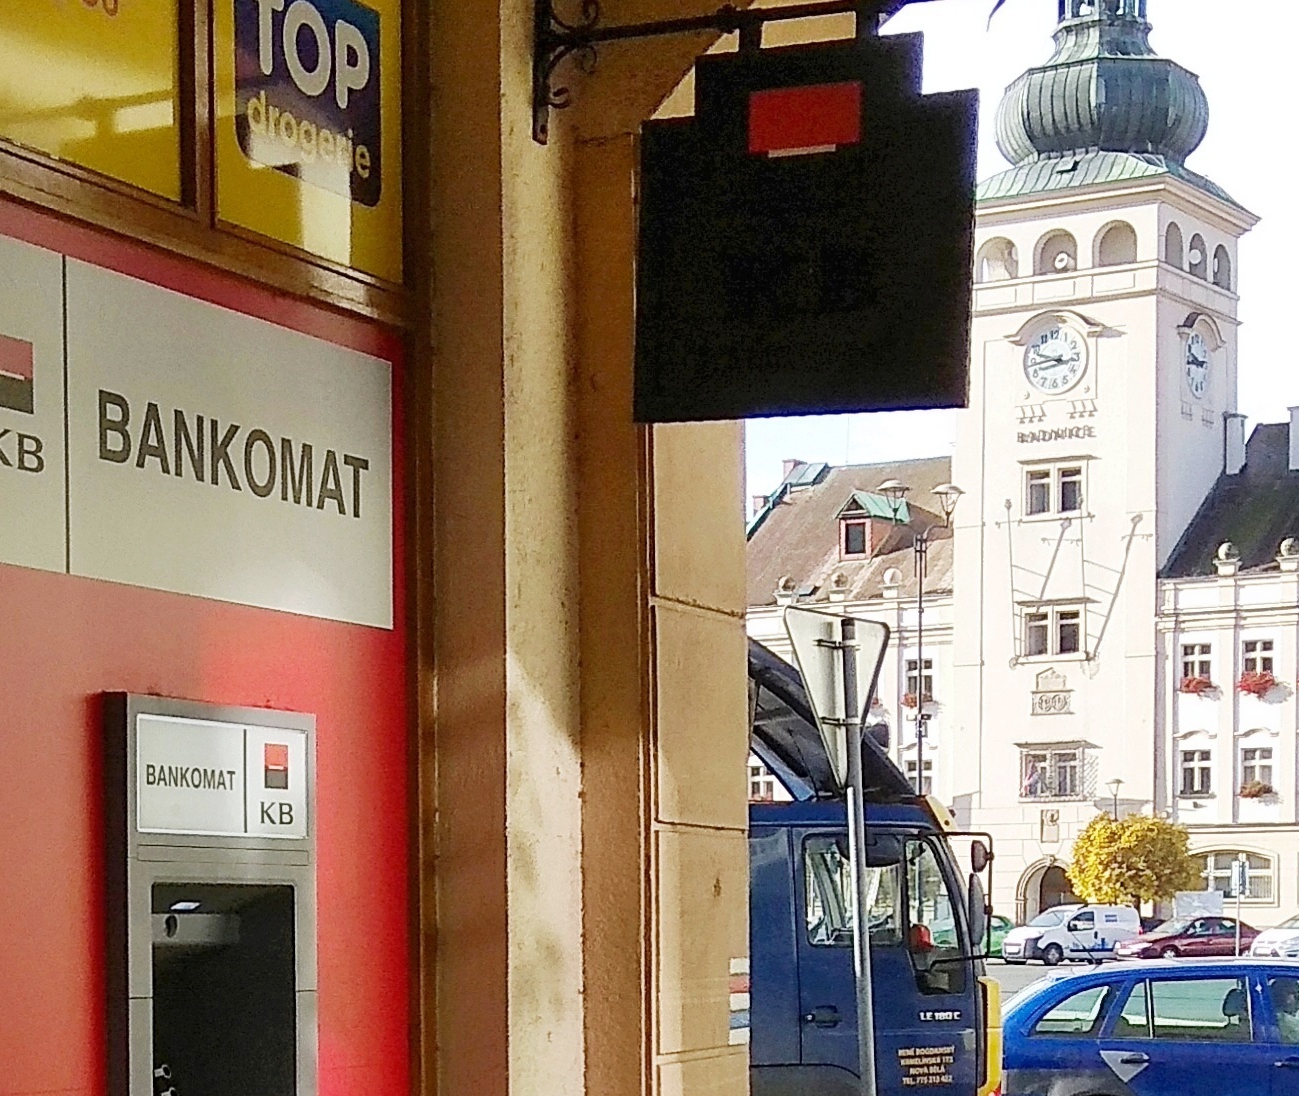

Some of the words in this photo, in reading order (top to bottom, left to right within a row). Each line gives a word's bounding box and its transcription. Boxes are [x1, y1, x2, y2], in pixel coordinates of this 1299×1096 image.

[257, 0, 370, 109] TOP
[247, 90, 371, 179] drogerie
[99, 388, 370, 519] BANKOMAT
[146, 764, 236, 791] BANKOMAT
[260, 801, 294, 825] KB
